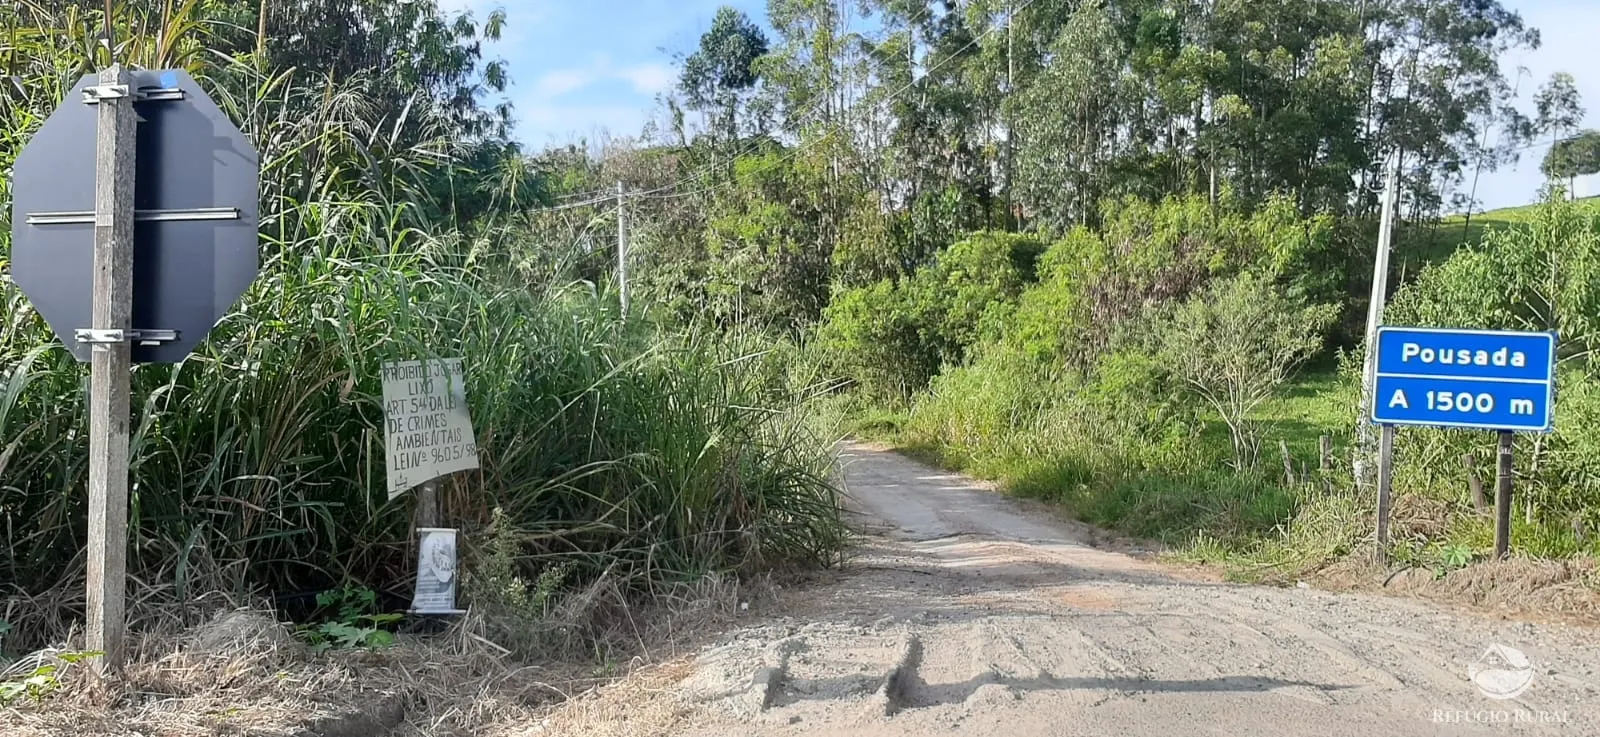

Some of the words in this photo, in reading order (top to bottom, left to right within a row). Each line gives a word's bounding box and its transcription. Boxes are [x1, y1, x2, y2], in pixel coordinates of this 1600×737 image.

[1401, 342, 1526, 368] Pousada
[408, 379, 434, 396] LIXO
[387, 398, 407, 415] ART
[429, 396, 443, 411] DA
[1388, 388, 1409, 409] A
[1426, 390, 1494, 414] 1500
[1509, 398, 1534, 416] m
[389, 418, 403, 434] DE
[408, 413, 447, 432] CRIMES
[396, 427, 462, 451] AMBIENTAIS
[431, 443, 477, 464] 9605/98
